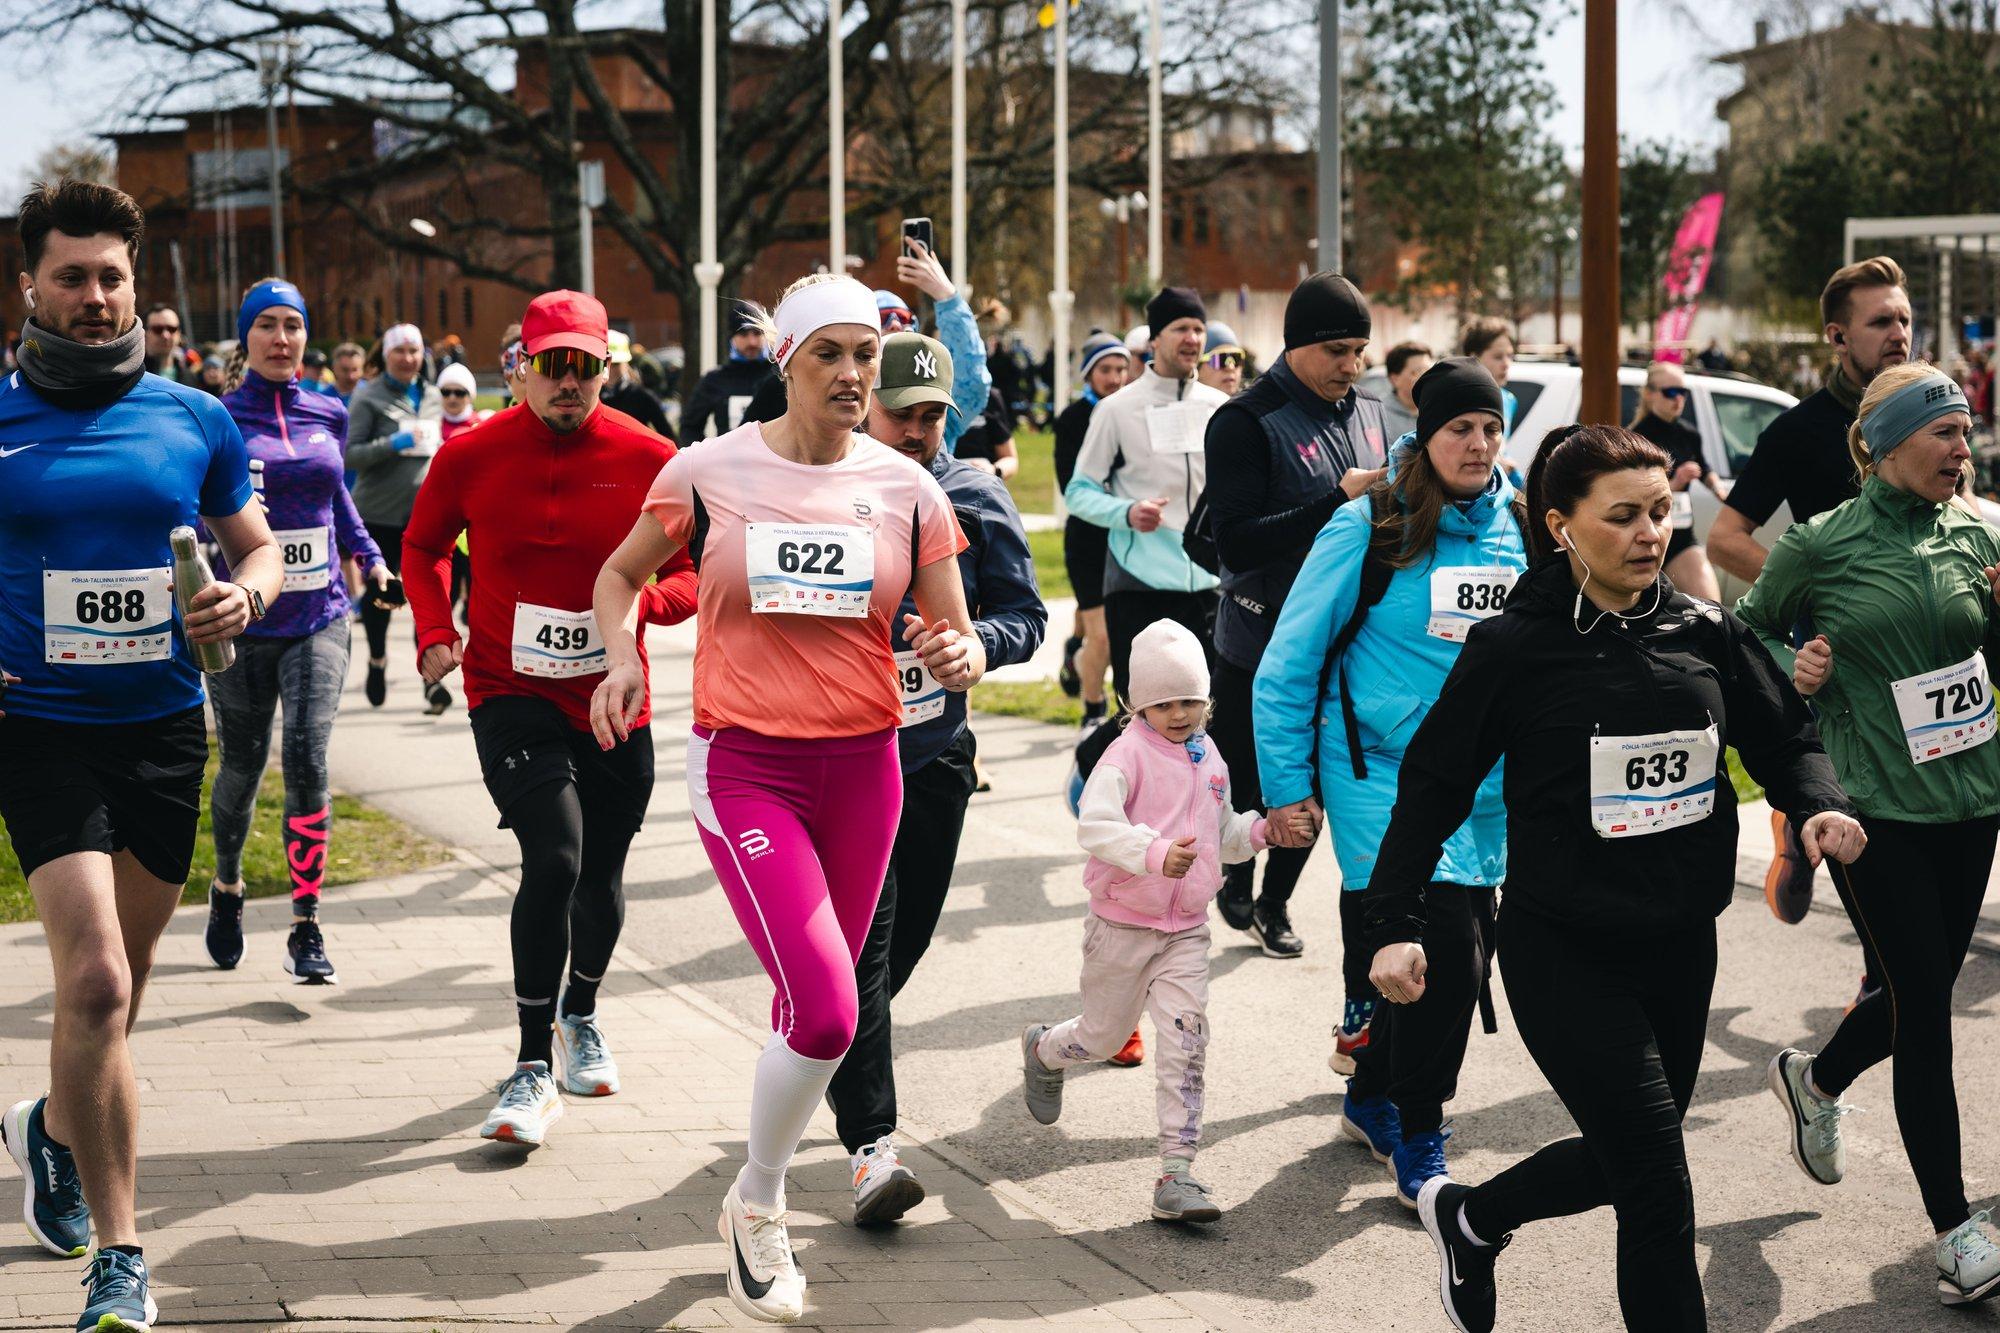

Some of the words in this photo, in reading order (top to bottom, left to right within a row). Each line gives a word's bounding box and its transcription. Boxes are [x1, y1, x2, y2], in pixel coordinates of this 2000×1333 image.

[913, 349, 937, 379] NY
[281, 542, 312, 565] 80
[778, 541, 844, 575] 622
[71, 576, 114, 584] PÕHJA-TALLINNA
[1457, 582, 1507, 610] 838
[76, 590, 145, 624] 688
[536, 624, 589, 650] 439
[1925, 676, 1984, 720] 720
[1625, 750, 1690, 791] 633
[287, 804, 330, 900] VSX
